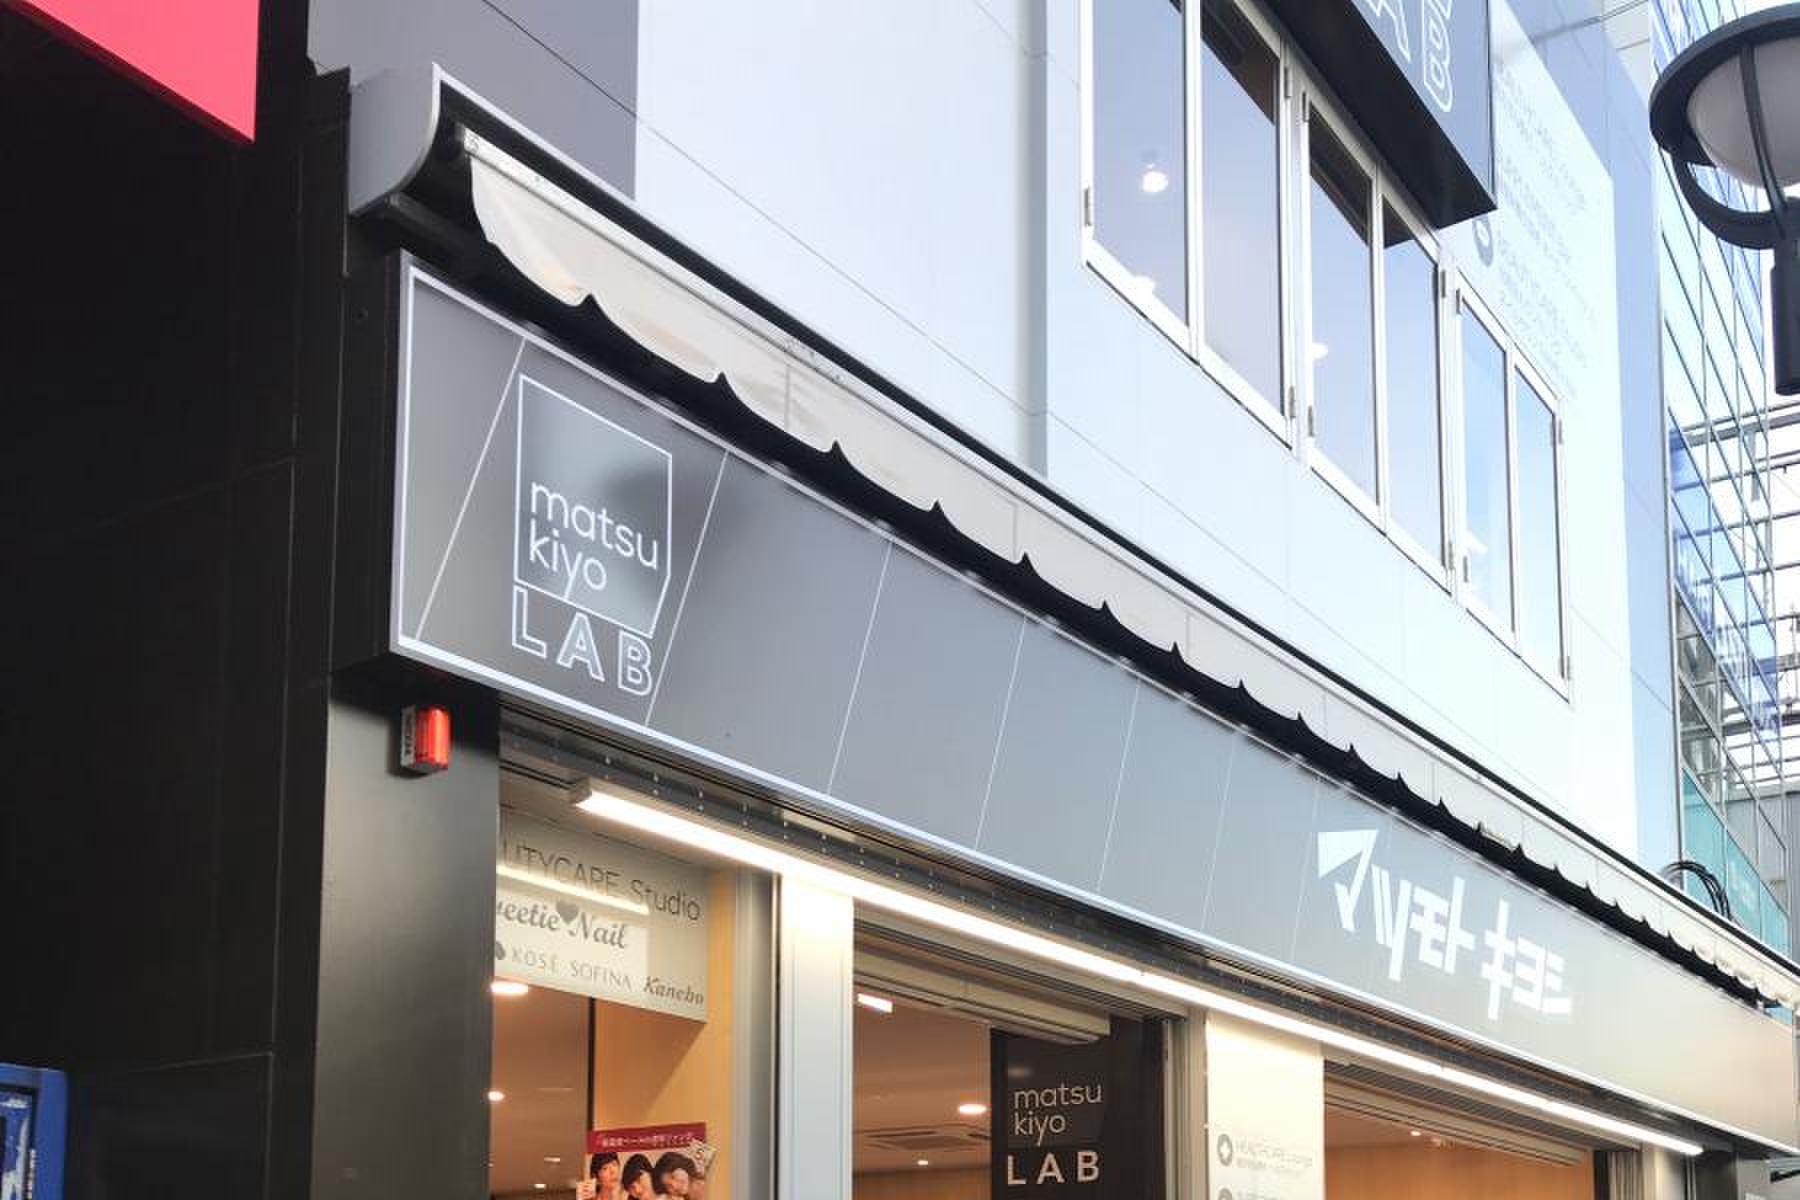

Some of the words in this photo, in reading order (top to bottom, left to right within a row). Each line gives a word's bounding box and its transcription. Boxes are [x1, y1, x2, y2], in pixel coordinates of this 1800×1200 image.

[530, 482, 658, 570] matsu
[529, 518, 607, 601] kiyo
[511, 584, 652, 696] LAB
[630, 879, 701, 921] Studio
[568, 909, 627, 949] Nail
[1013, 1083, 1102, 1109] matsu
[1014, 1110, 1066, 1147] kiyo
[1007, 1150, 1100, 1185] LAB
